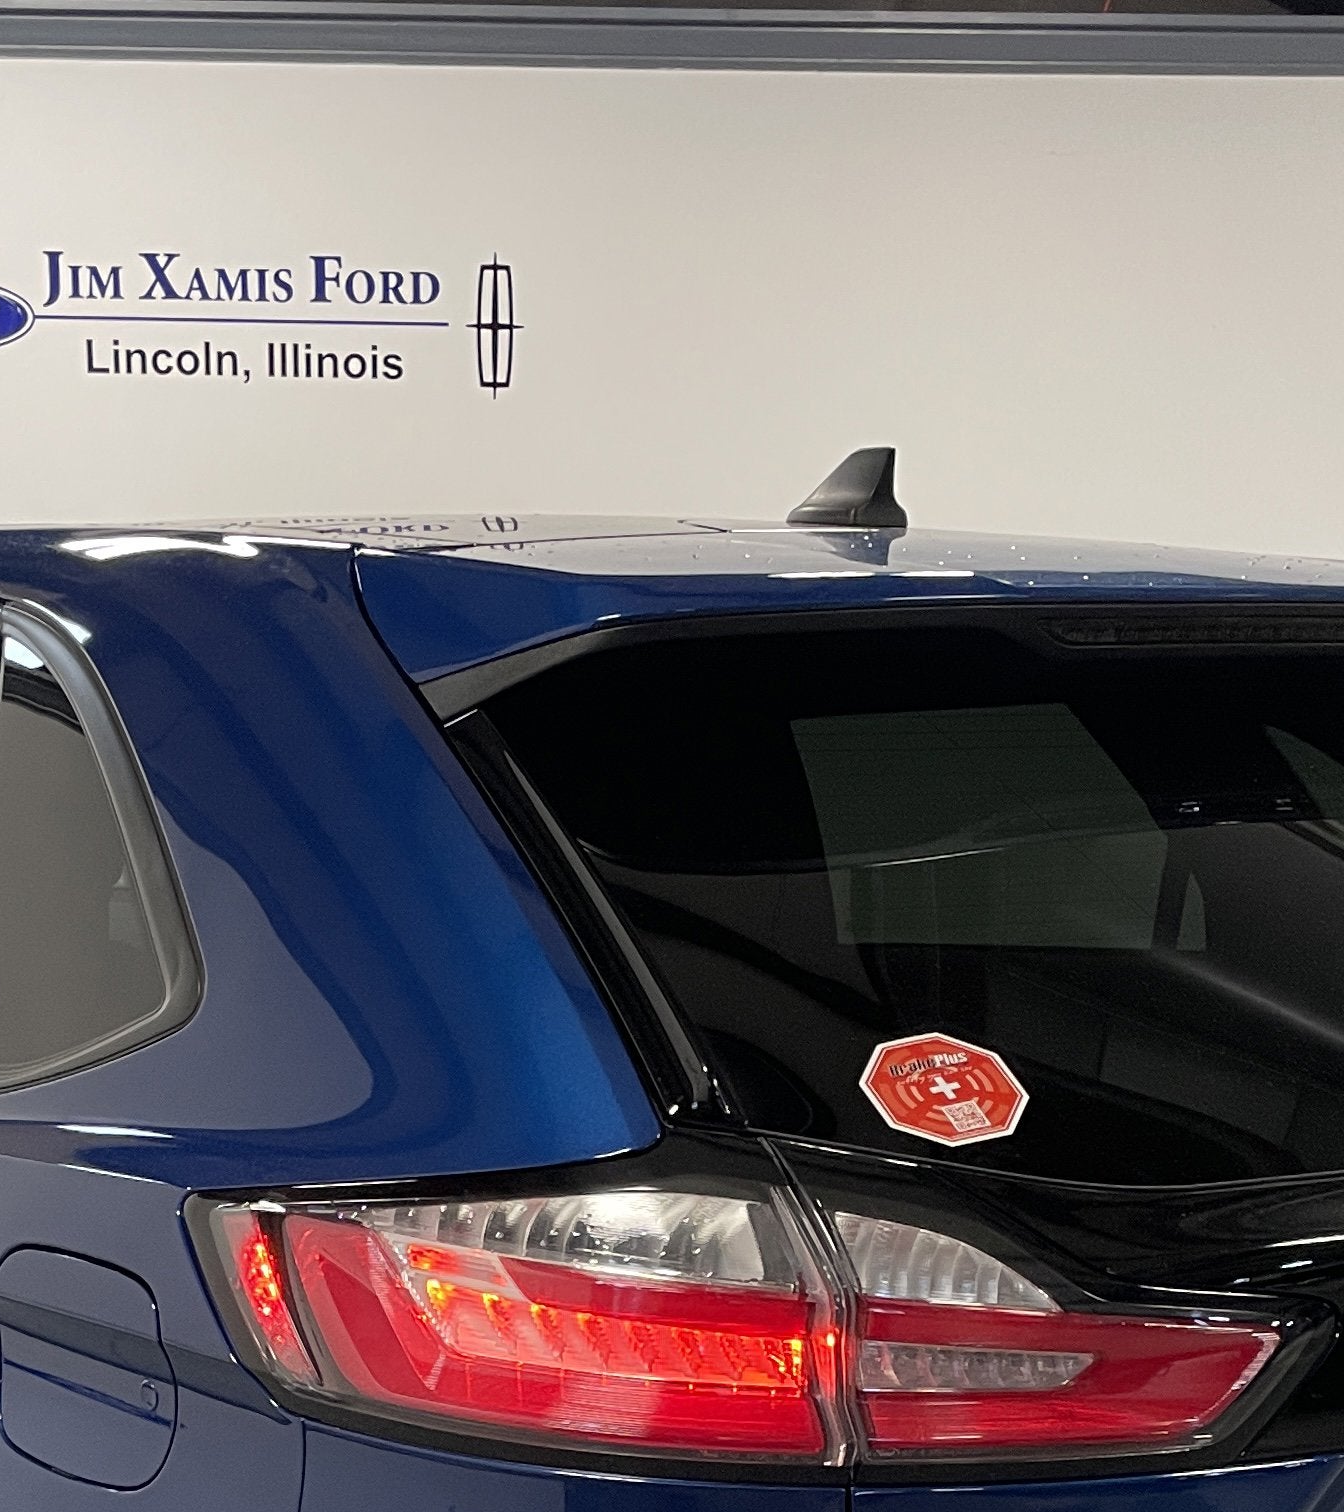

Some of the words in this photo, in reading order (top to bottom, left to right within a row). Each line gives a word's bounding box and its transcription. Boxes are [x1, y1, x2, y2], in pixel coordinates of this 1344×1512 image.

[43, 250, 124, 308] JIM
[138, 252, 294, 304] XAMIS
[309, 255, 441, 305] FORD
[85, 338, 251, 384] Lincoln,
[267, 342, 404, 380] Illinois
